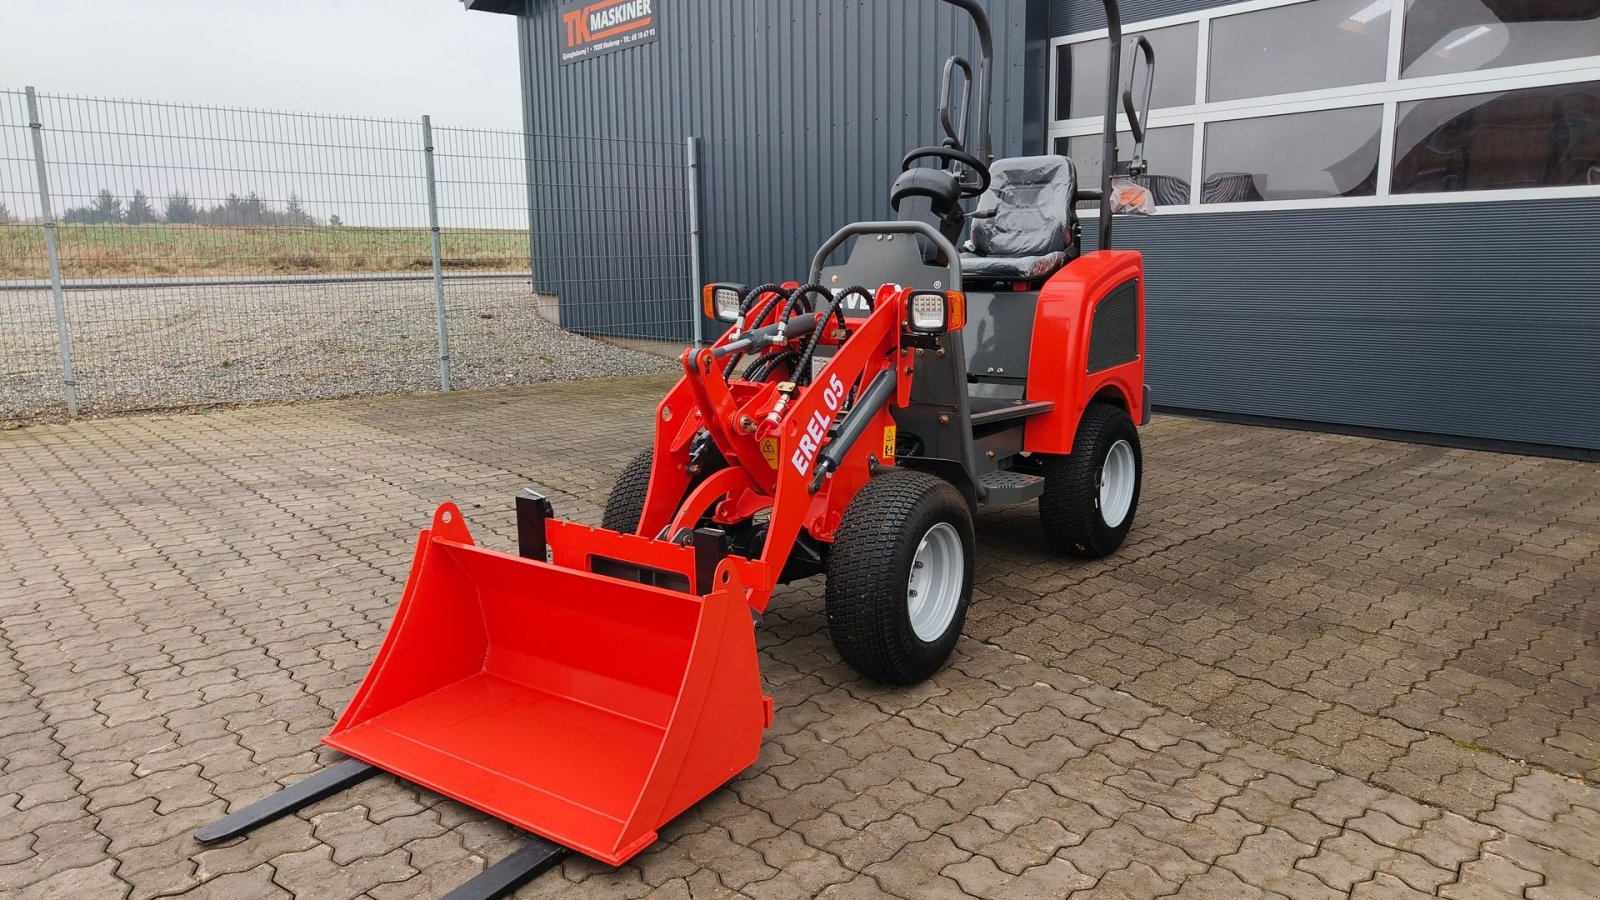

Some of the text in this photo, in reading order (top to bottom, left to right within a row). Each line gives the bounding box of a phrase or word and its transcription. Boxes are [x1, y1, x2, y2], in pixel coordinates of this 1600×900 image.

[563, 0, 651, 47] TK MASKINER
[791, 409, 831, 476] EREL
[823, 372, 844, 411] 05
